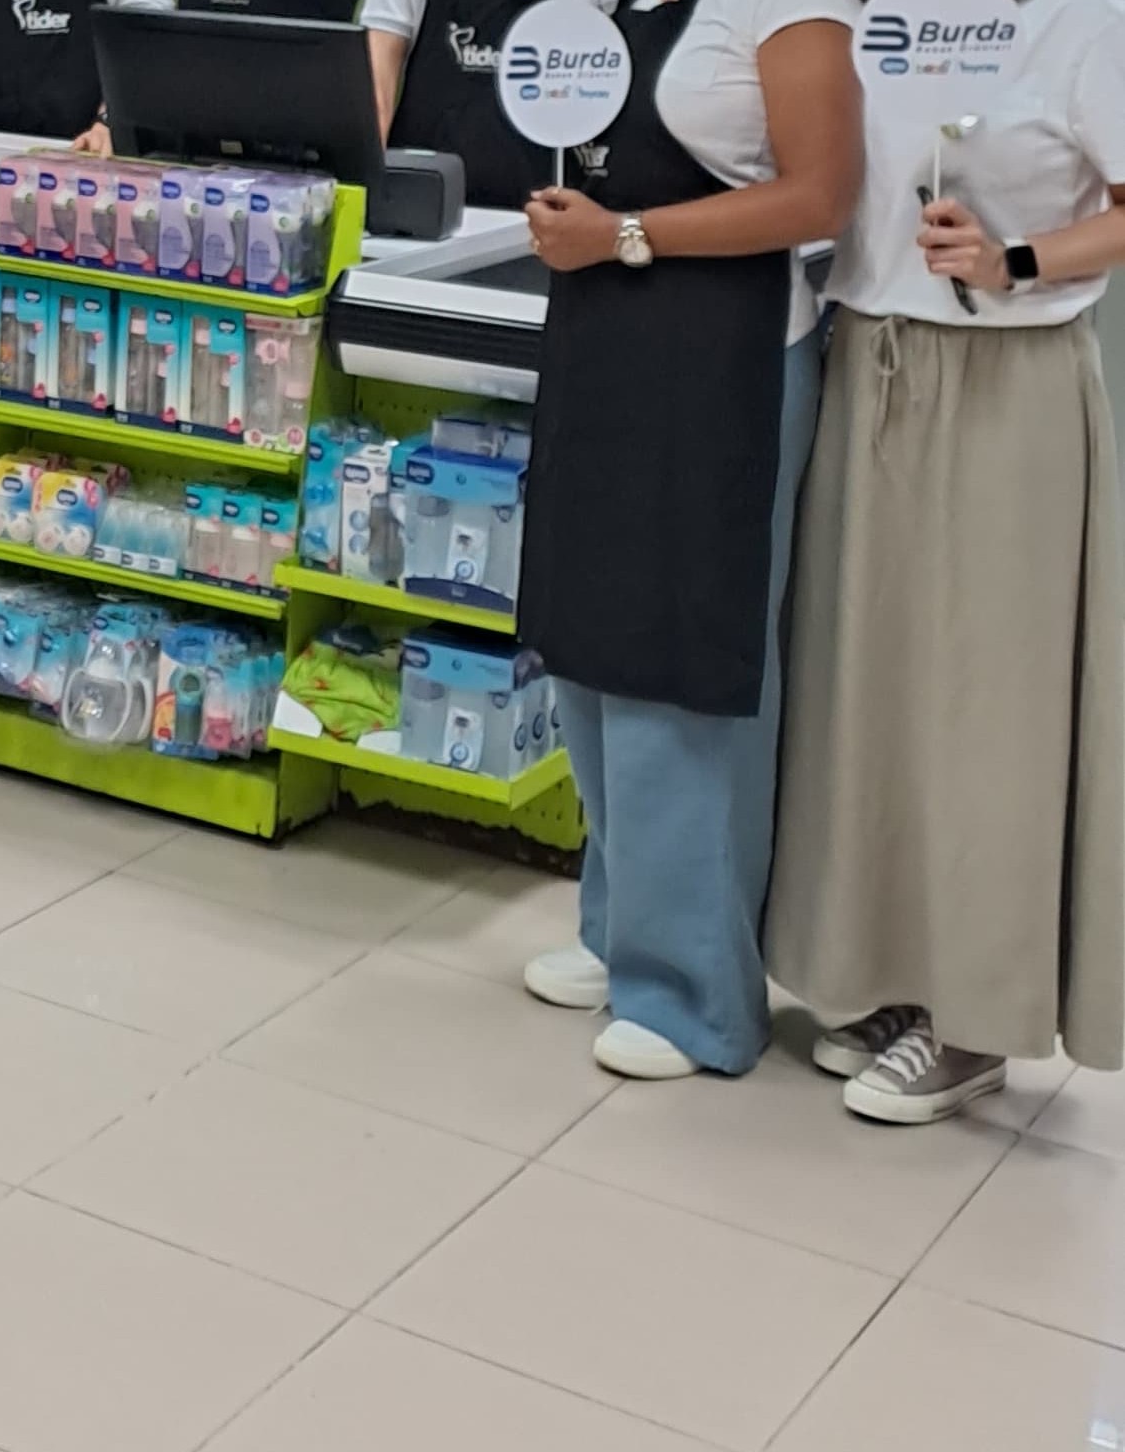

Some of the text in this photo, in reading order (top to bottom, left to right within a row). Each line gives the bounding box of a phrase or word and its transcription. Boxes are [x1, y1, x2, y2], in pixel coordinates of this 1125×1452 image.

[26, 8, 72, 29] tider
[918, 18, 1016, 43] Burda
[546, 46, 622, 70] Burda
